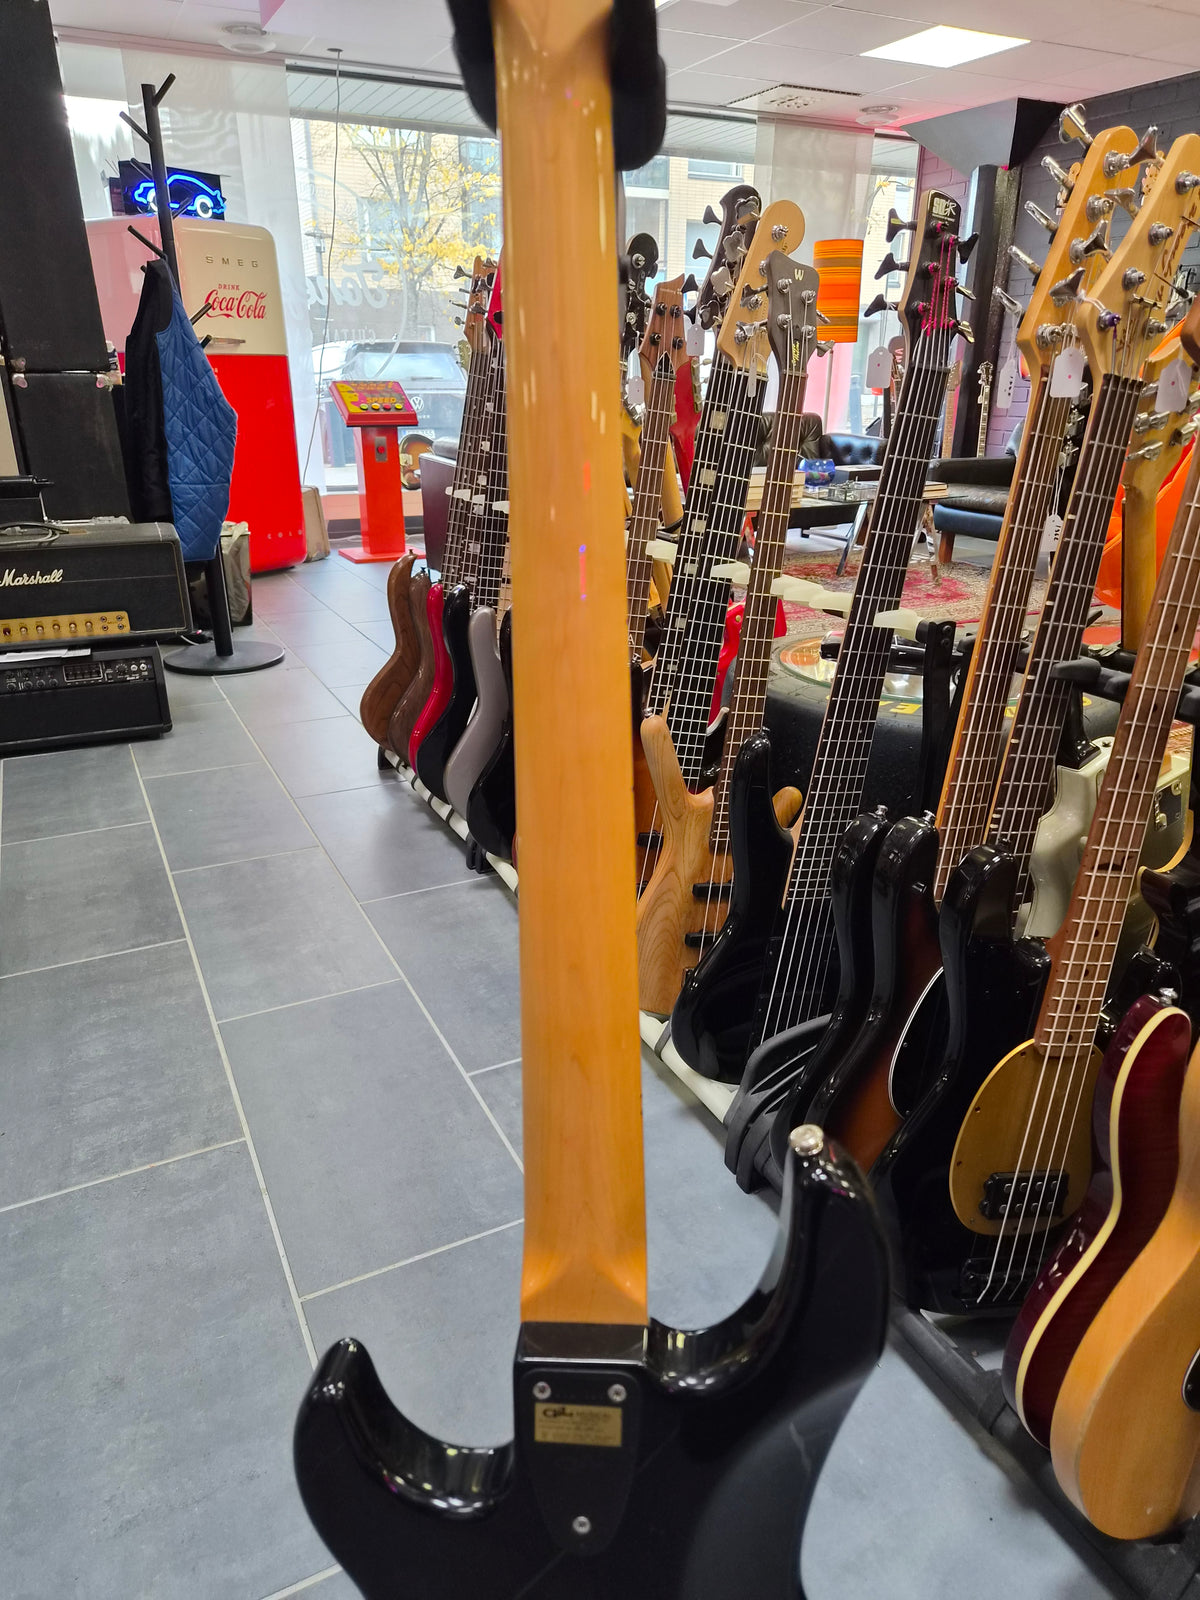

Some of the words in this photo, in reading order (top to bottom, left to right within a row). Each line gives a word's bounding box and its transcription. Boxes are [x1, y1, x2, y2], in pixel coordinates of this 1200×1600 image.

[205, 256, 259, 268] SMEG
[217, 283, 240, 291] DRINK
[0, 568, 64, 587] Marshall
